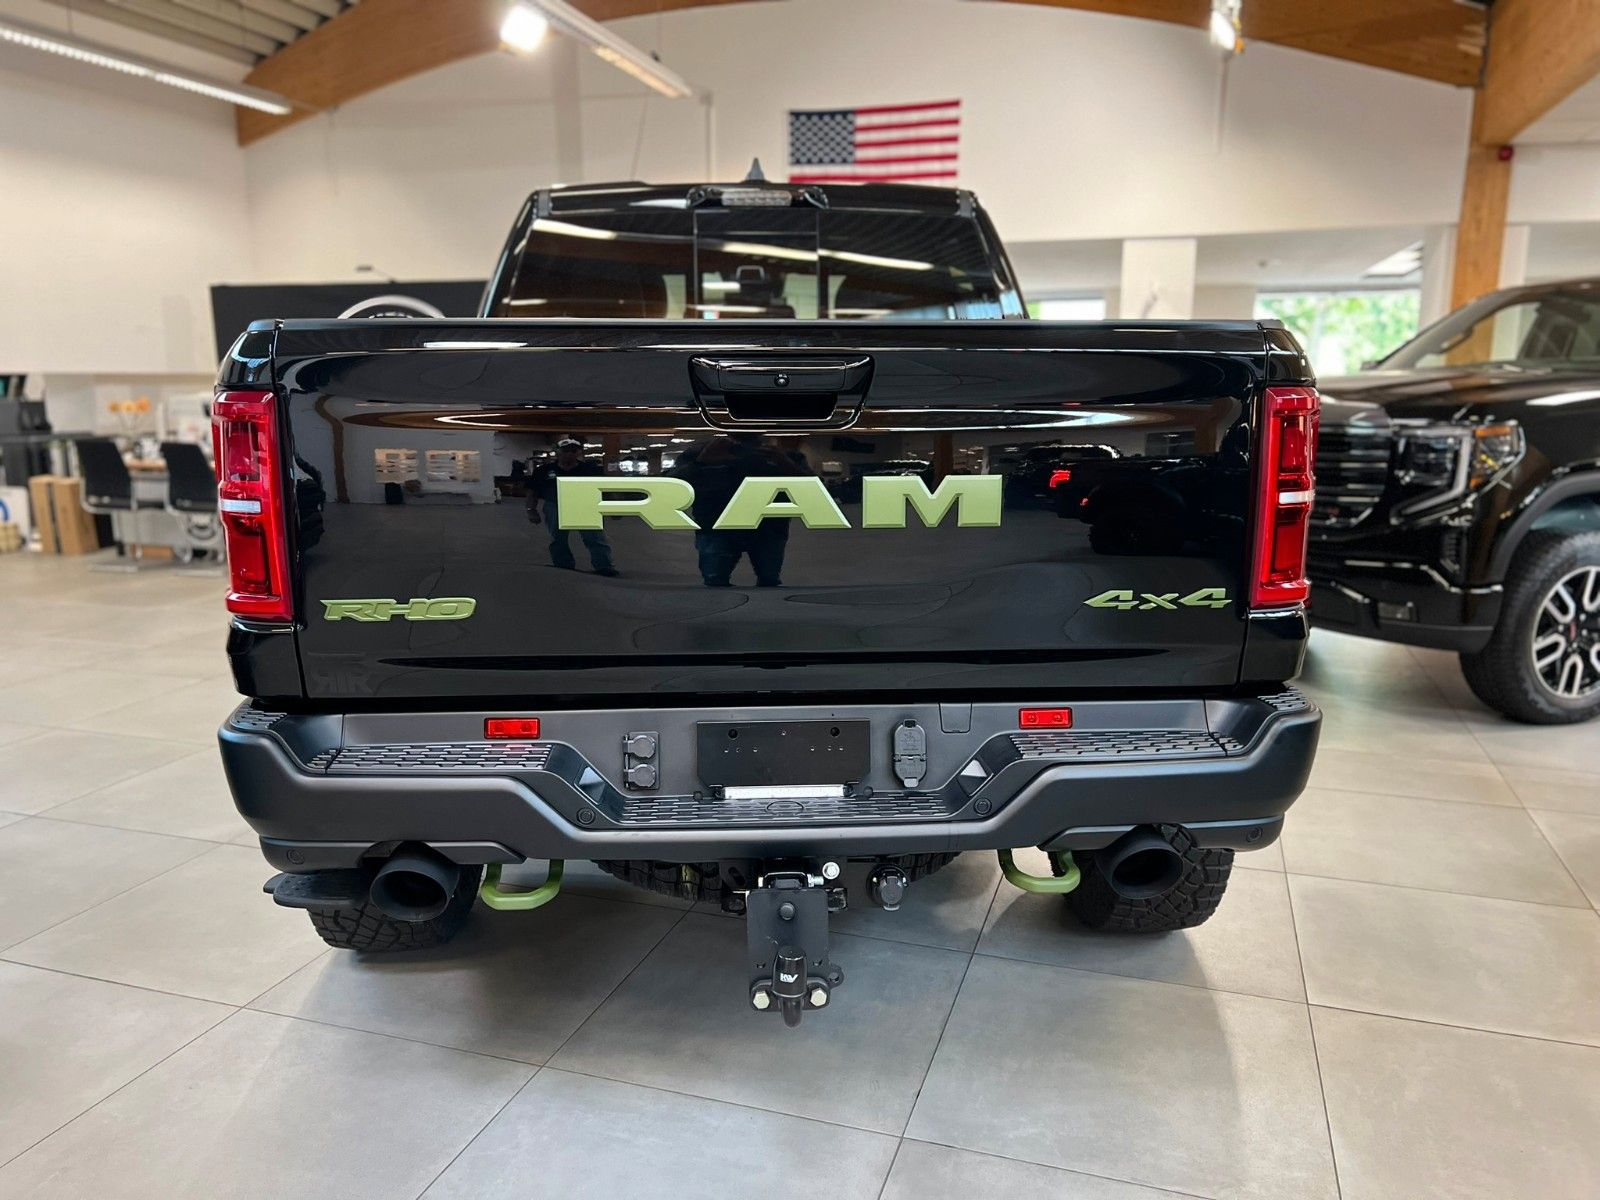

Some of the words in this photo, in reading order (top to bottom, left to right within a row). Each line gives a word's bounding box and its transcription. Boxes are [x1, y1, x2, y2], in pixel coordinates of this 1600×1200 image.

[556, 473, 1003, 530] RAM
[320, 596, 477, 622] RHO
[1083, 587, 1232, 610] 4x4
